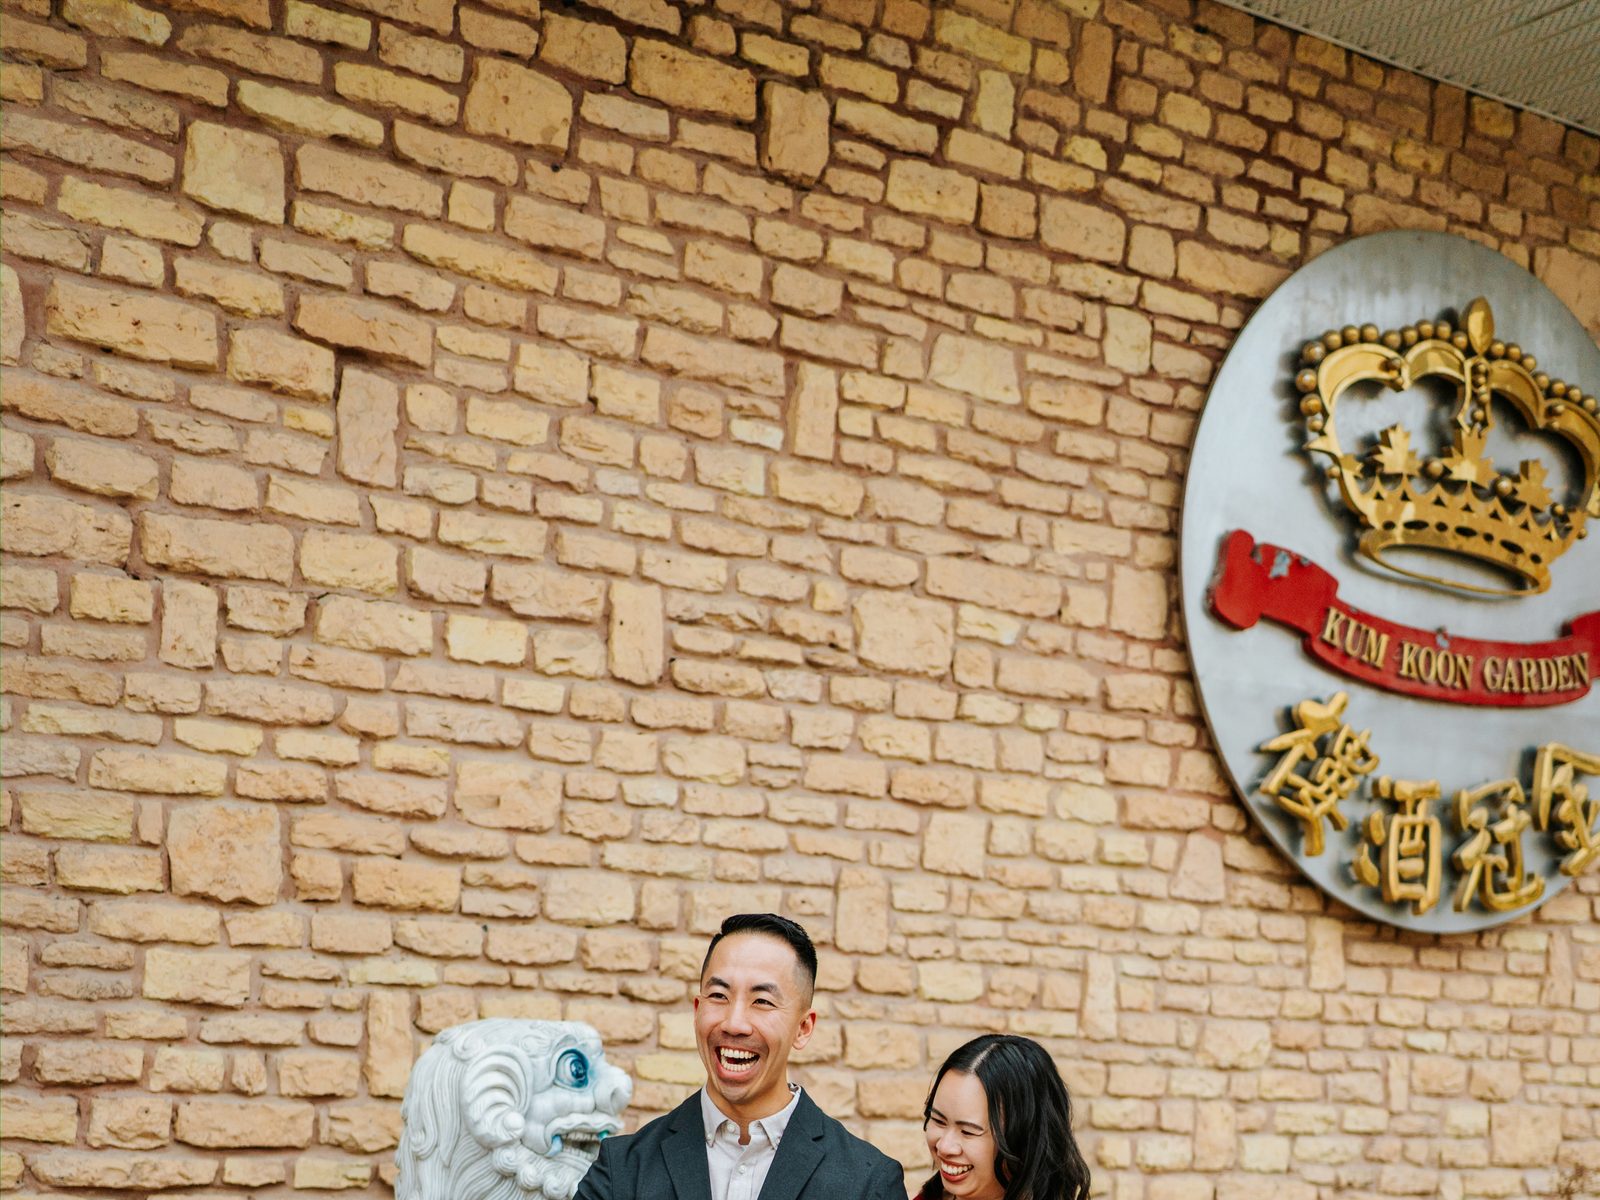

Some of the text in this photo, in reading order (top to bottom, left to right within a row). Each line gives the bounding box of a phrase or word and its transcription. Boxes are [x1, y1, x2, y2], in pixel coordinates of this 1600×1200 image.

[1321, 606, 1589, 693] KUM KOON GARDEN
